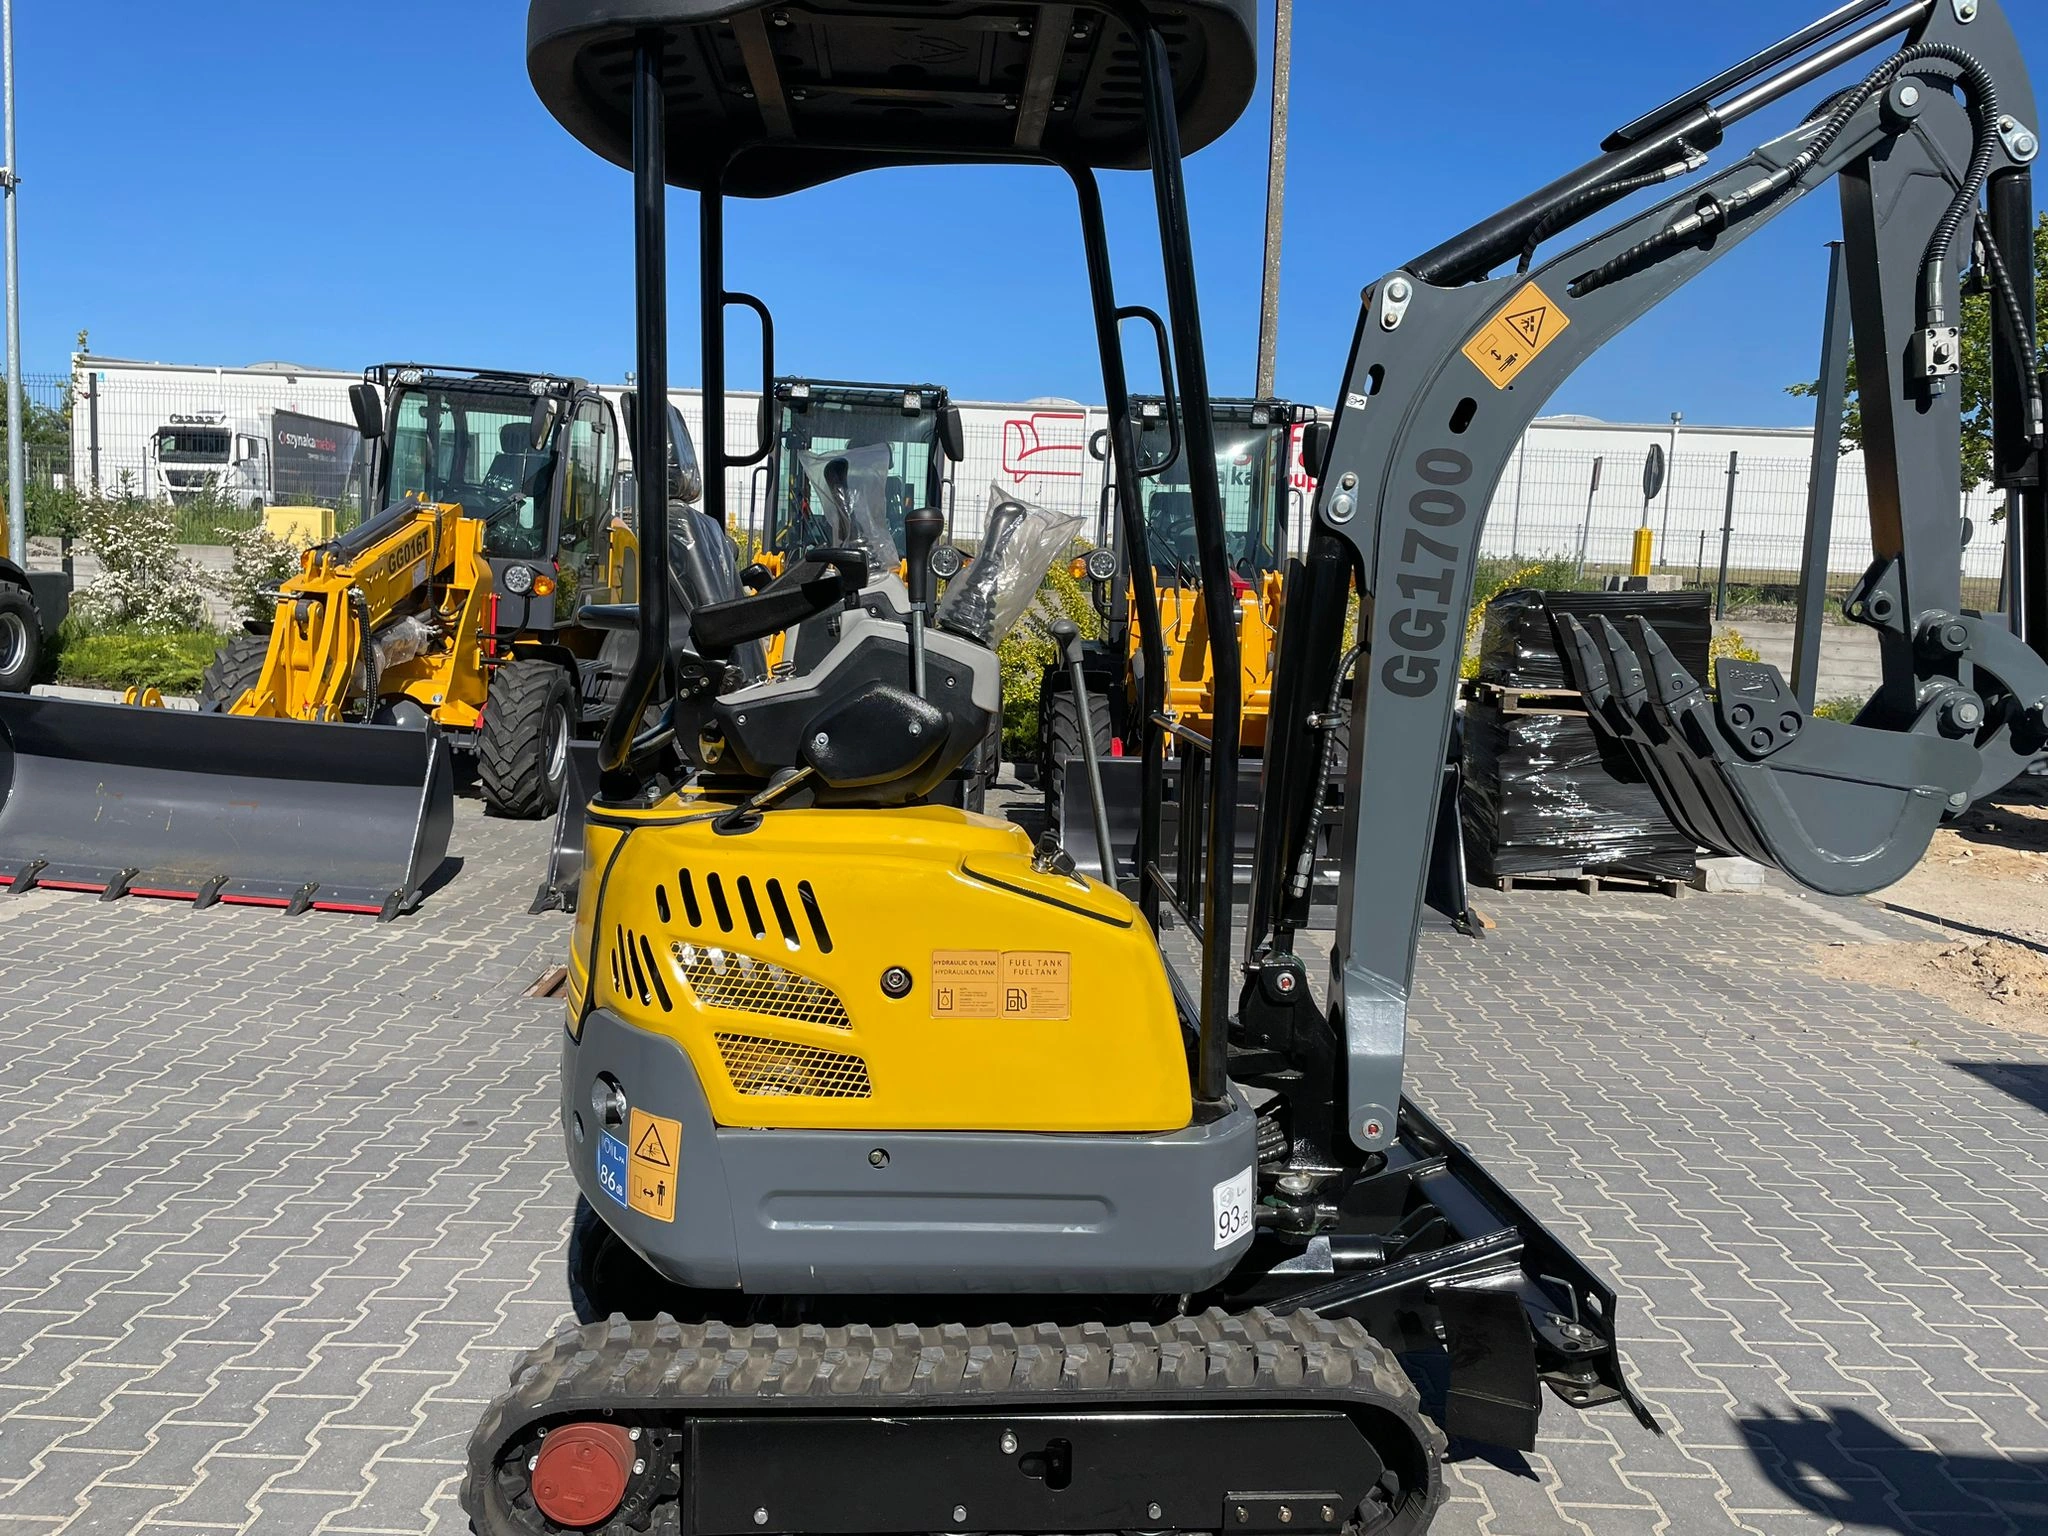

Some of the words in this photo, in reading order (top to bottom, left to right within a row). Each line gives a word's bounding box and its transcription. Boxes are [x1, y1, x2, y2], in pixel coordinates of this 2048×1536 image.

[388, 529, 429, 575] GG016T
[1381, 447, 1473, 698] GG1700
[980, 959, 997, 967] TANK
[1009, 959, 1033, 967] FUEL
[1037, 959, 1063, 968] TANK
[1013, 968, 1058, 976] FUELTANK
[600, 1163, 616, 1191] 86
[1219, 1205, 1240, 1239] 93
